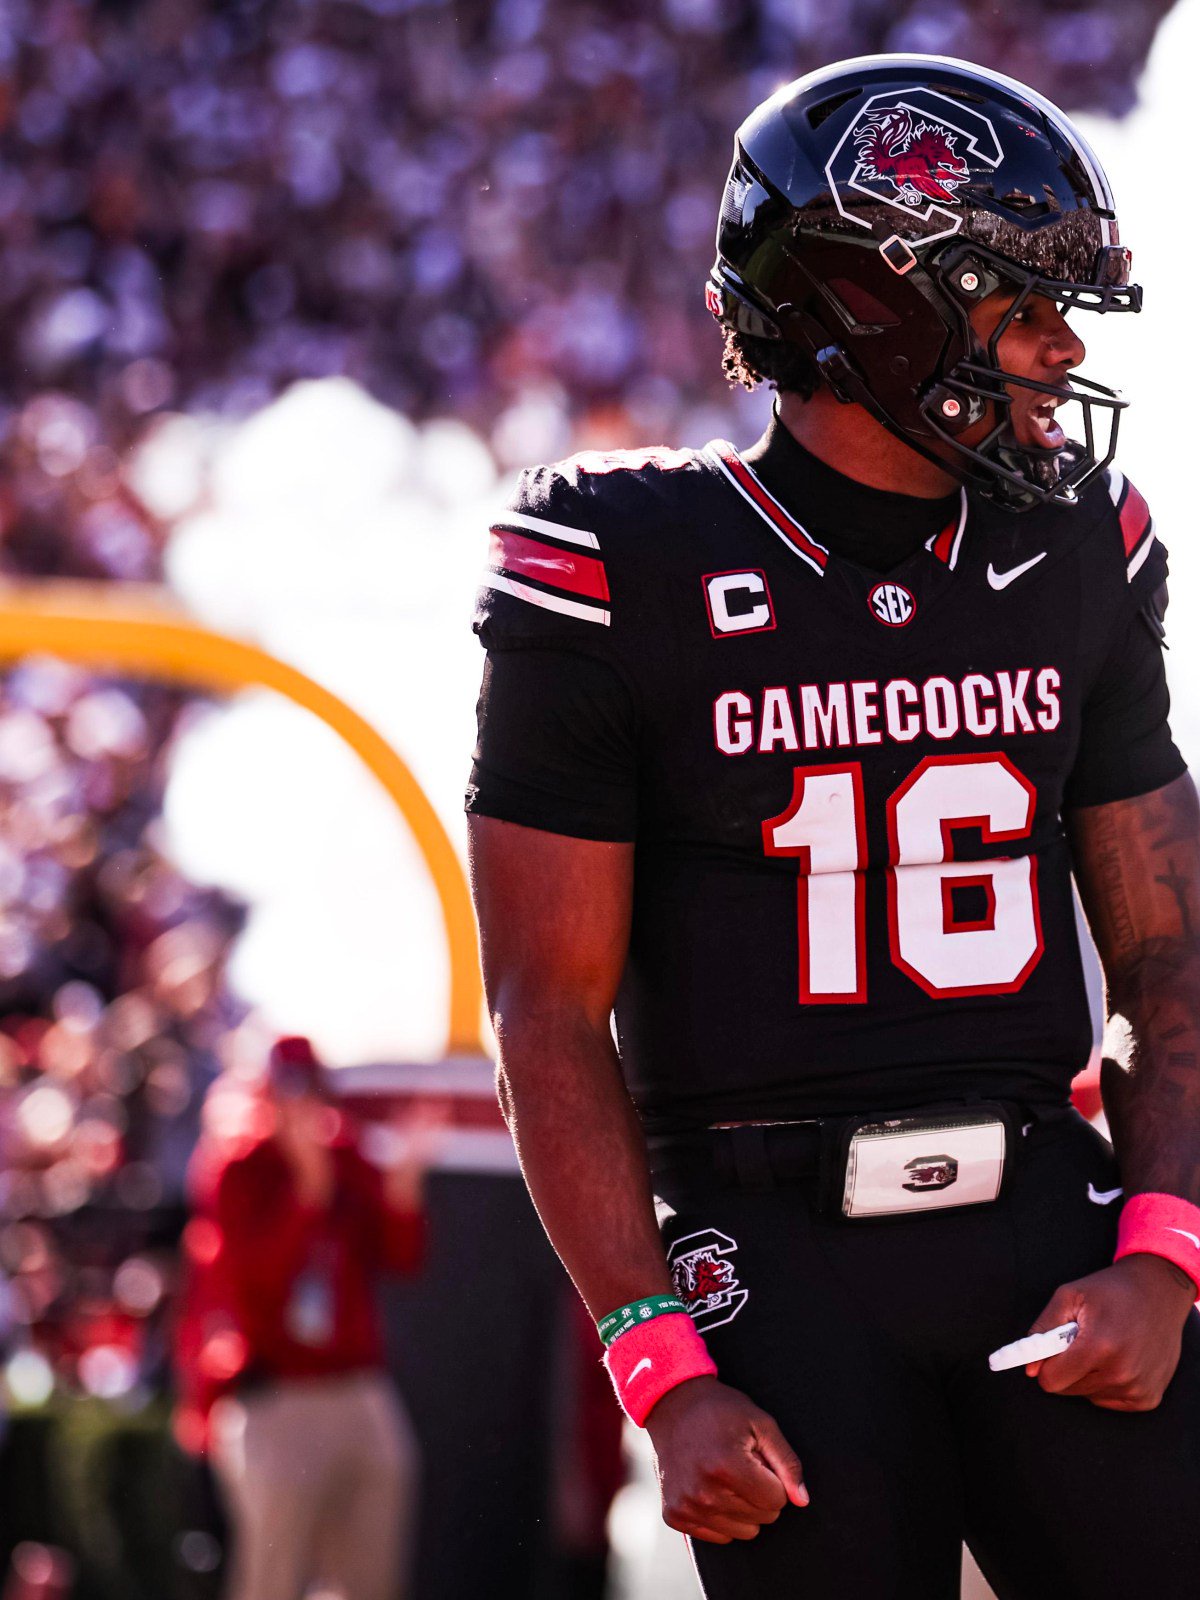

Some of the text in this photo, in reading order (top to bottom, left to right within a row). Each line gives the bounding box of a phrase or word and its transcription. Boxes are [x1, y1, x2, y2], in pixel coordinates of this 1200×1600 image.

[707, 572, 770, 633] C
[872, 583, 913, 624] SEC
[714, 666, 1061, 756] GAMECOCKS
[761, 752, 1045, 1005] 16
